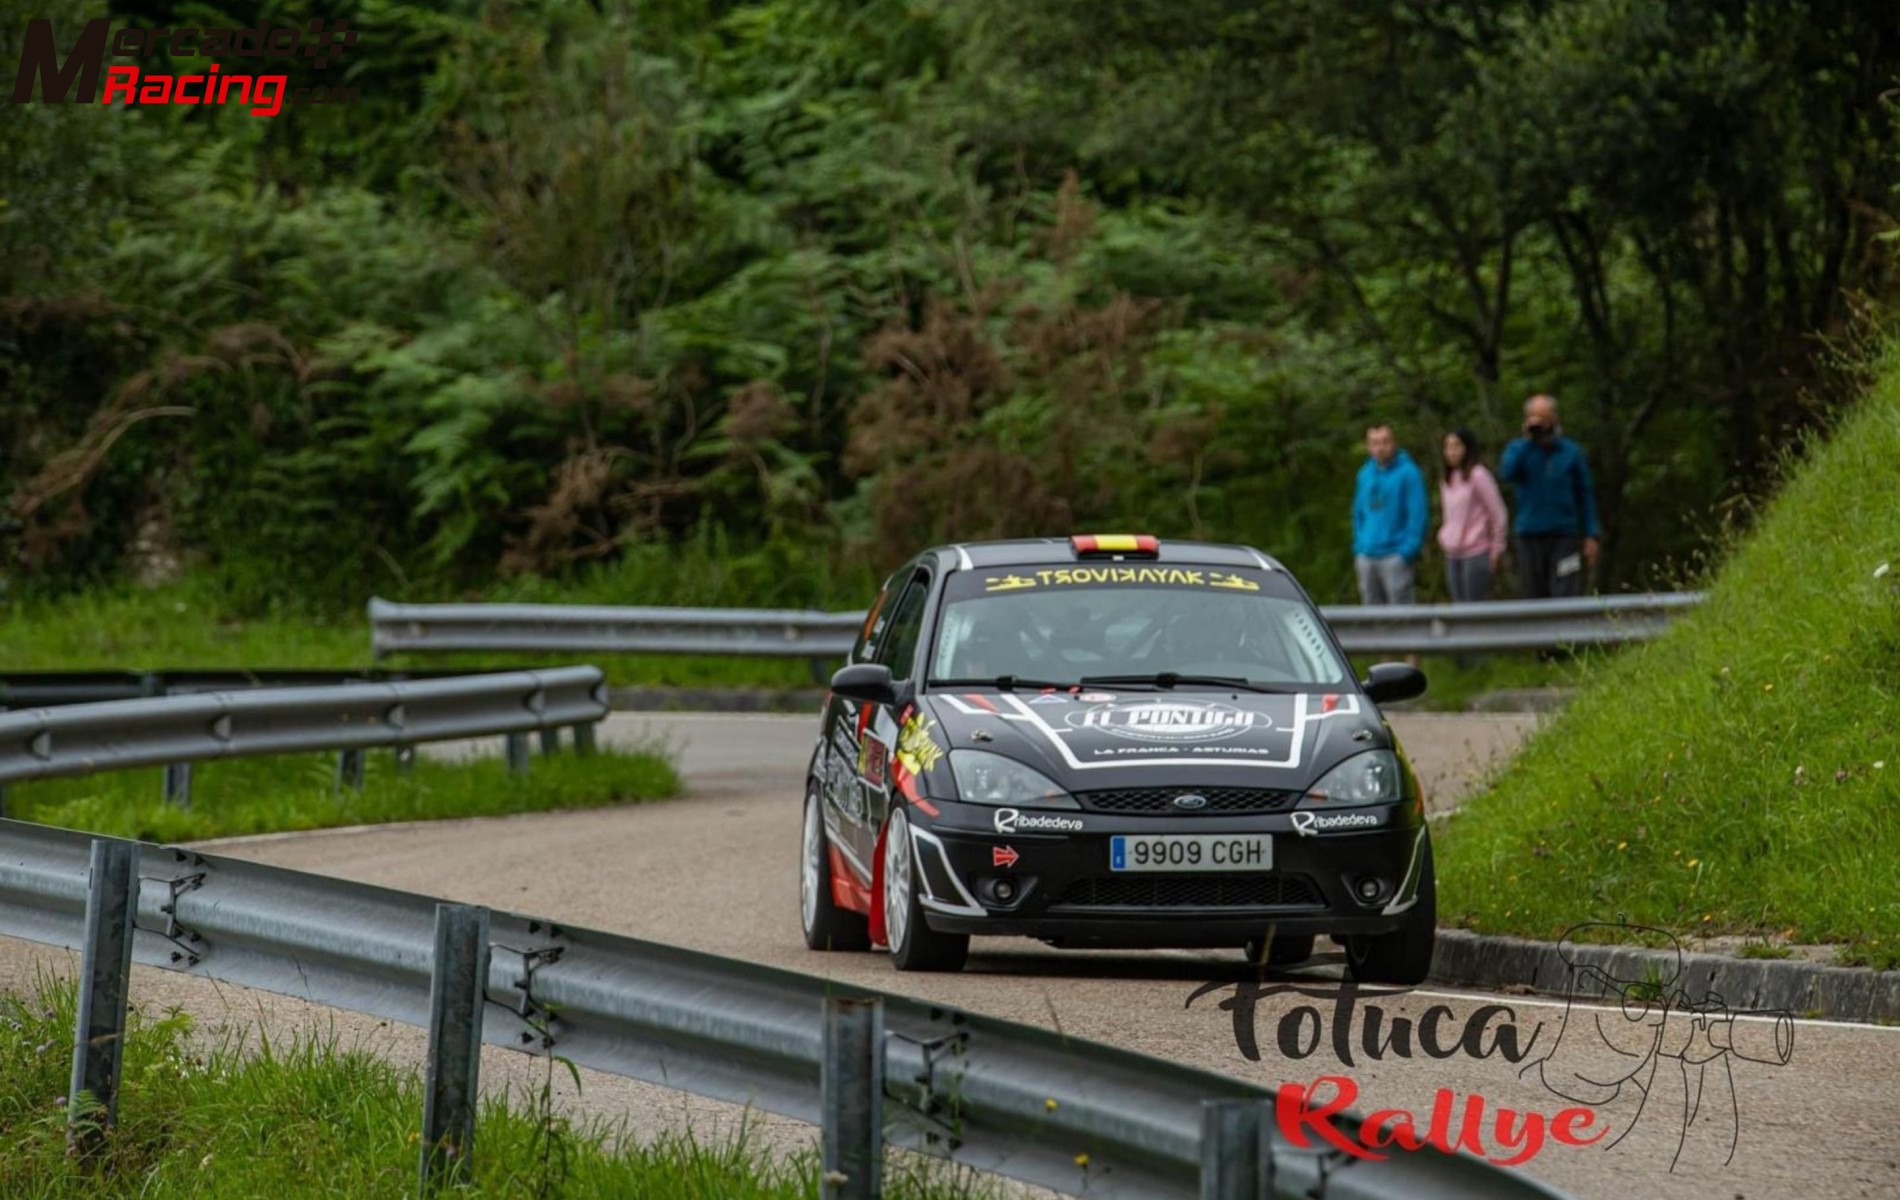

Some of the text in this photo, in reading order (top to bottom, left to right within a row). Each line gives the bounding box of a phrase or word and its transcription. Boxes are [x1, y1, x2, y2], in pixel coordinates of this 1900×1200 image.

[1117, 746, 1179, 754] FRANCA
[1192, 746, 1269, 755] ASTURIAS
[994, 807, 1084, 833] Ribadedeva
[1290, 811, 1378, 836] Ribadedeva
[1134, 840, 1261, 865] 9909 CGH
